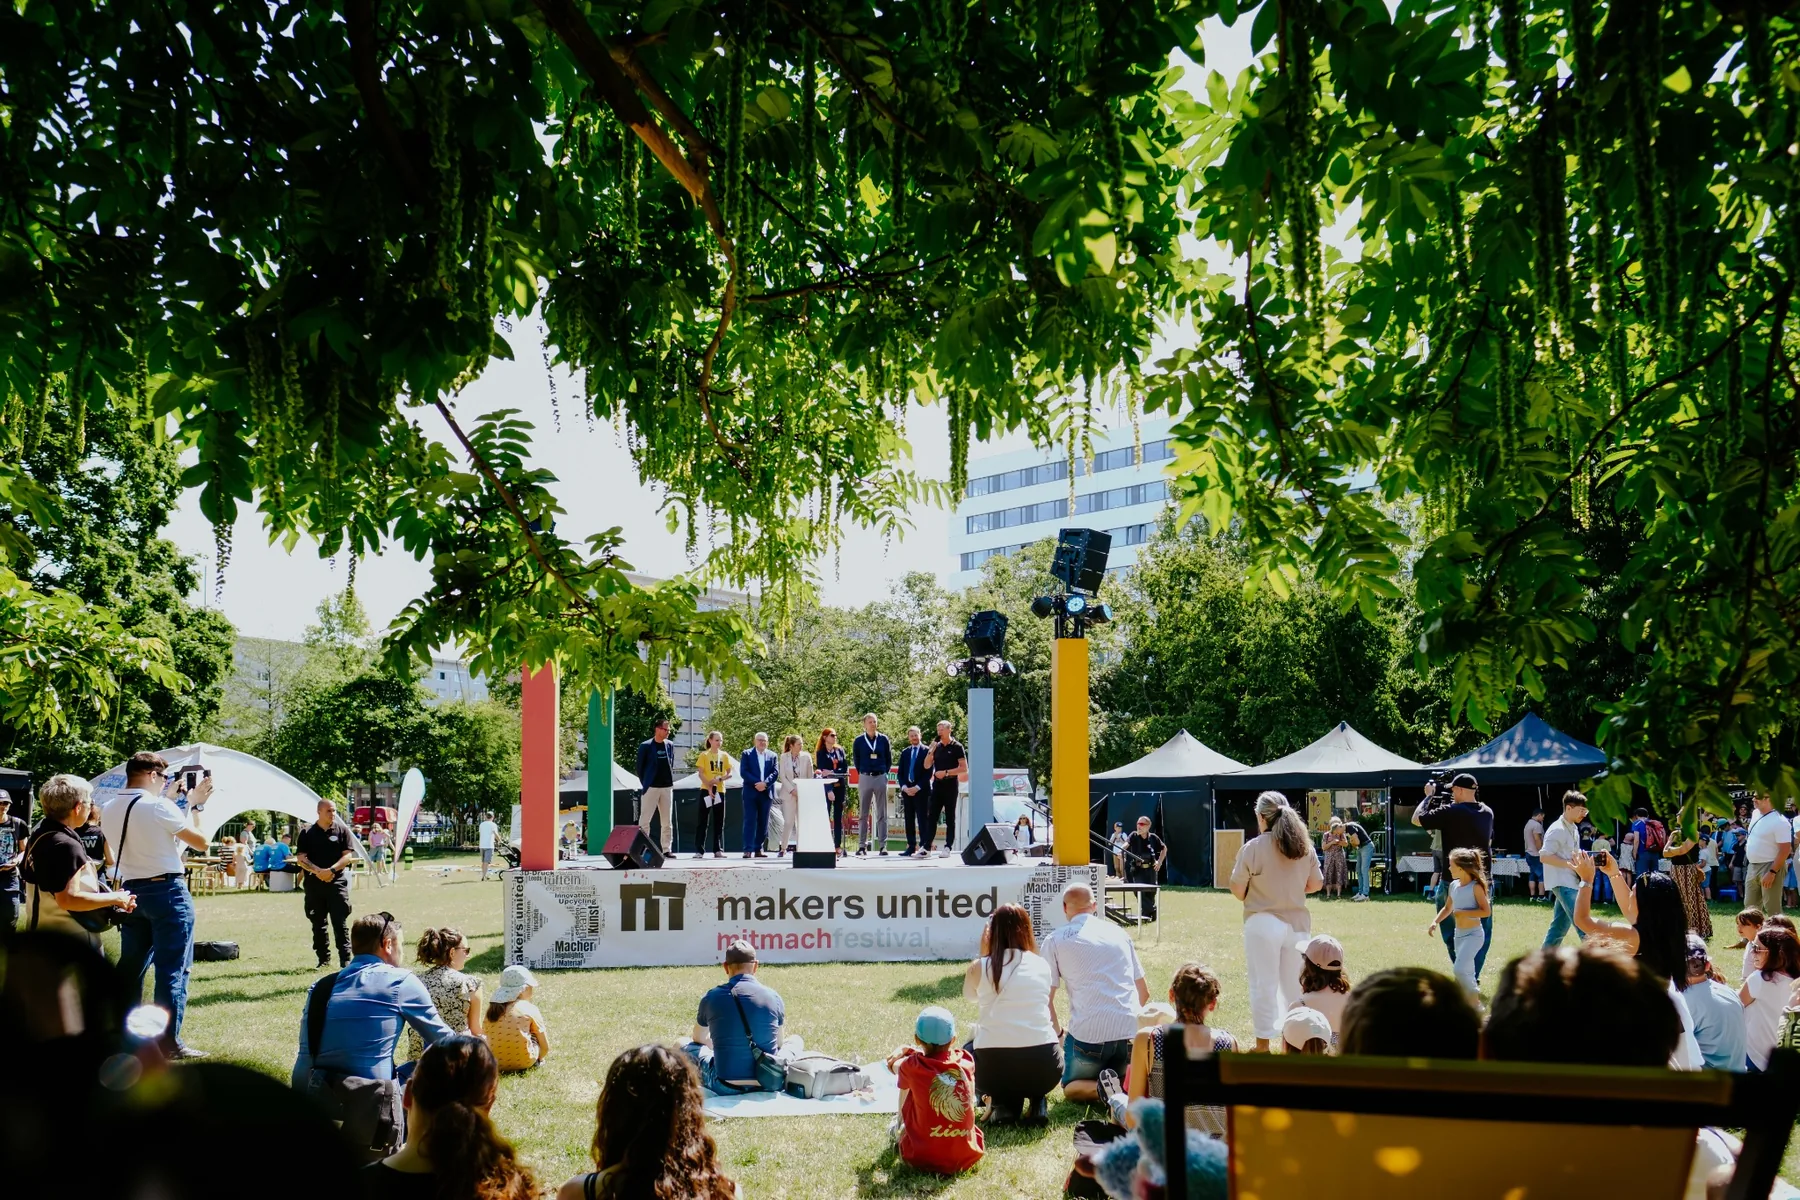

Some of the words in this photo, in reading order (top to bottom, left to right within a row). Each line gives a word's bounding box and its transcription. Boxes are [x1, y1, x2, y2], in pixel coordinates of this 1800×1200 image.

[544, 874, 581, 886] tüfteln
[1026, 883, 1062, 893] Macher
[514, 876, 524, 920] united
[558, 898, 597, 906] Upcycling
[717, 886, 865, 921] makers
[876, 886, 998, 920] united
[588, 905, 599, 934] Kunst
[555, 941, 594, 952] Macher
[554, 952, 584, 960] Highlights
[558, 959, 583, 967] Material
